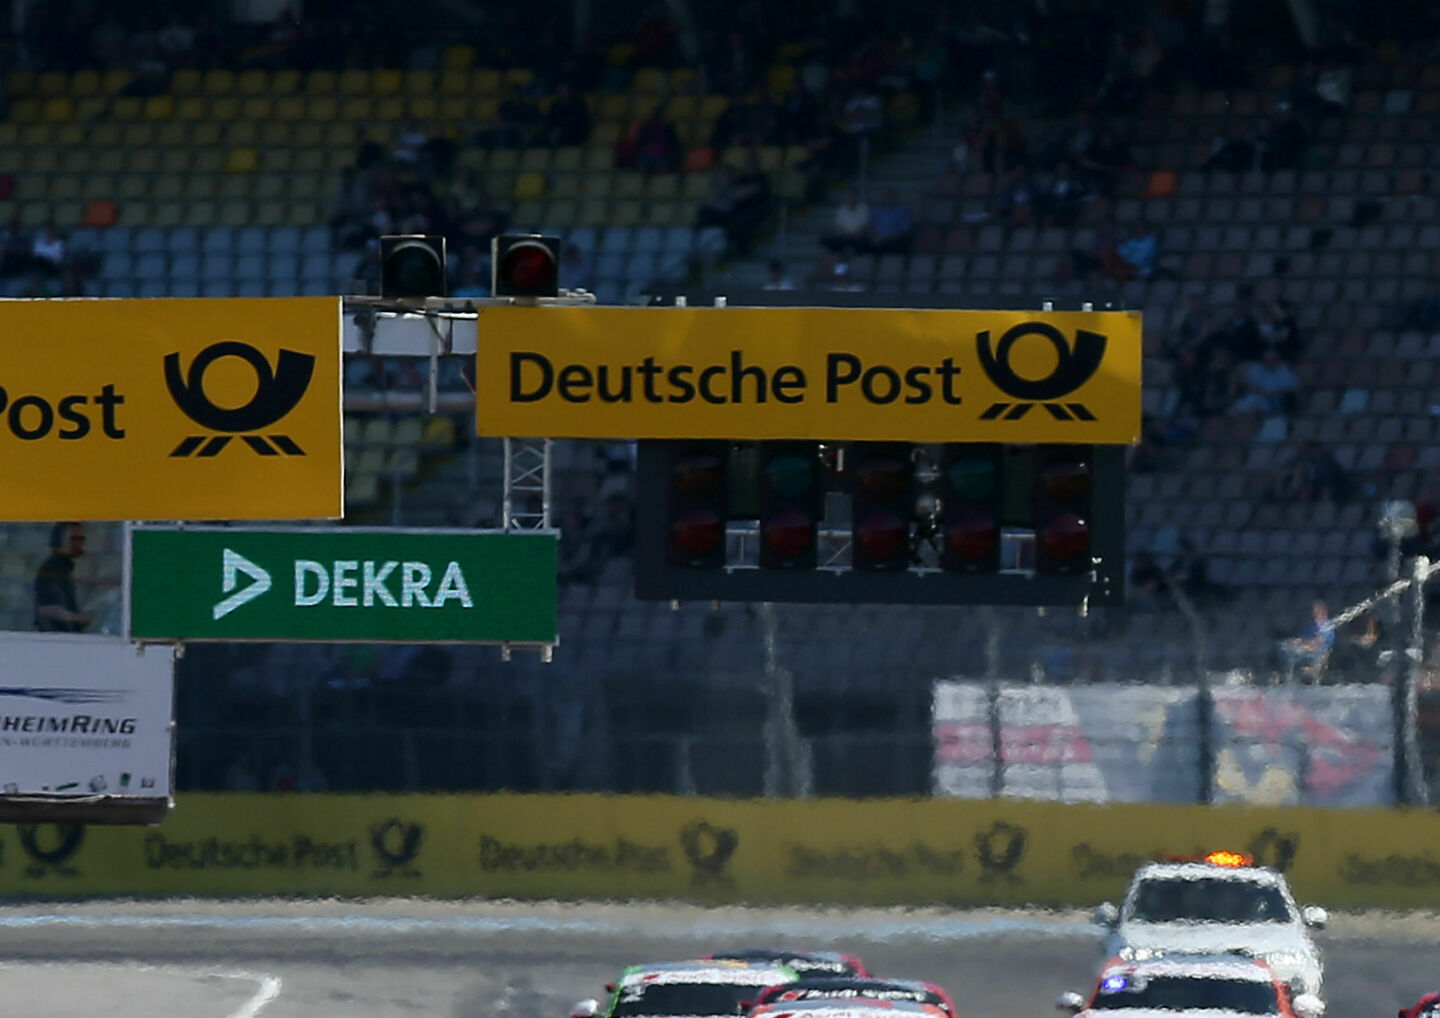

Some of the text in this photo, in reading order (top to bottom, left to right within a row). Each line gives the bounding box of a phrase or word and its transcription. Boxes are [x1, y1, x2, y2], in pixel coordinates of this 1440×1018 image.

[508, 349, 962, 405] Deutsche Post
[293, 558, 473, 610] DEKRA
